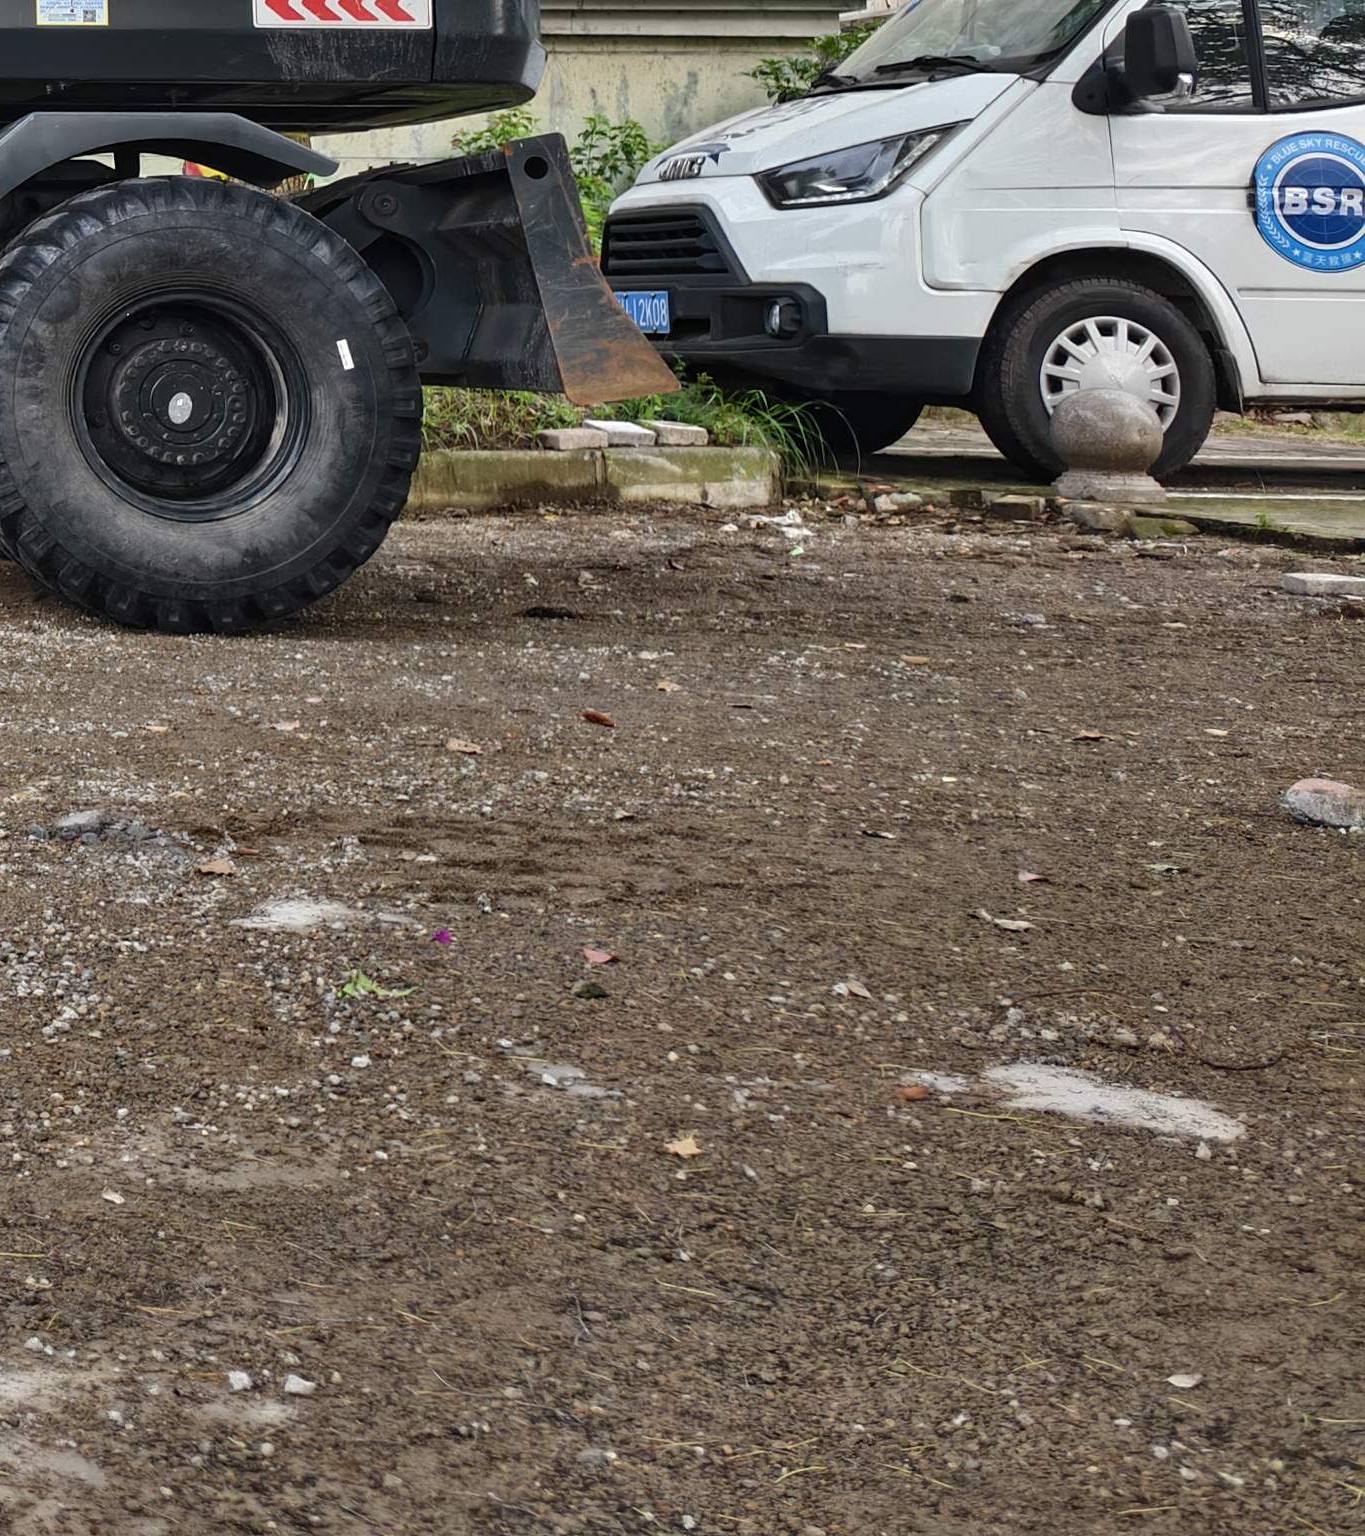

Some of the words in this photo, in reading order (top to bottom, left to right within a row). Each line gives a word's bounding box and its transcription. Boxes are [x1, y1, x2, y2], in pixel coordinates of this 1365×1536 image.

[1271, 143, 1299, 165] BLUE
[1299, 138, 1322, 150] SKY
[1282, 187, 1364, 216] BSR
